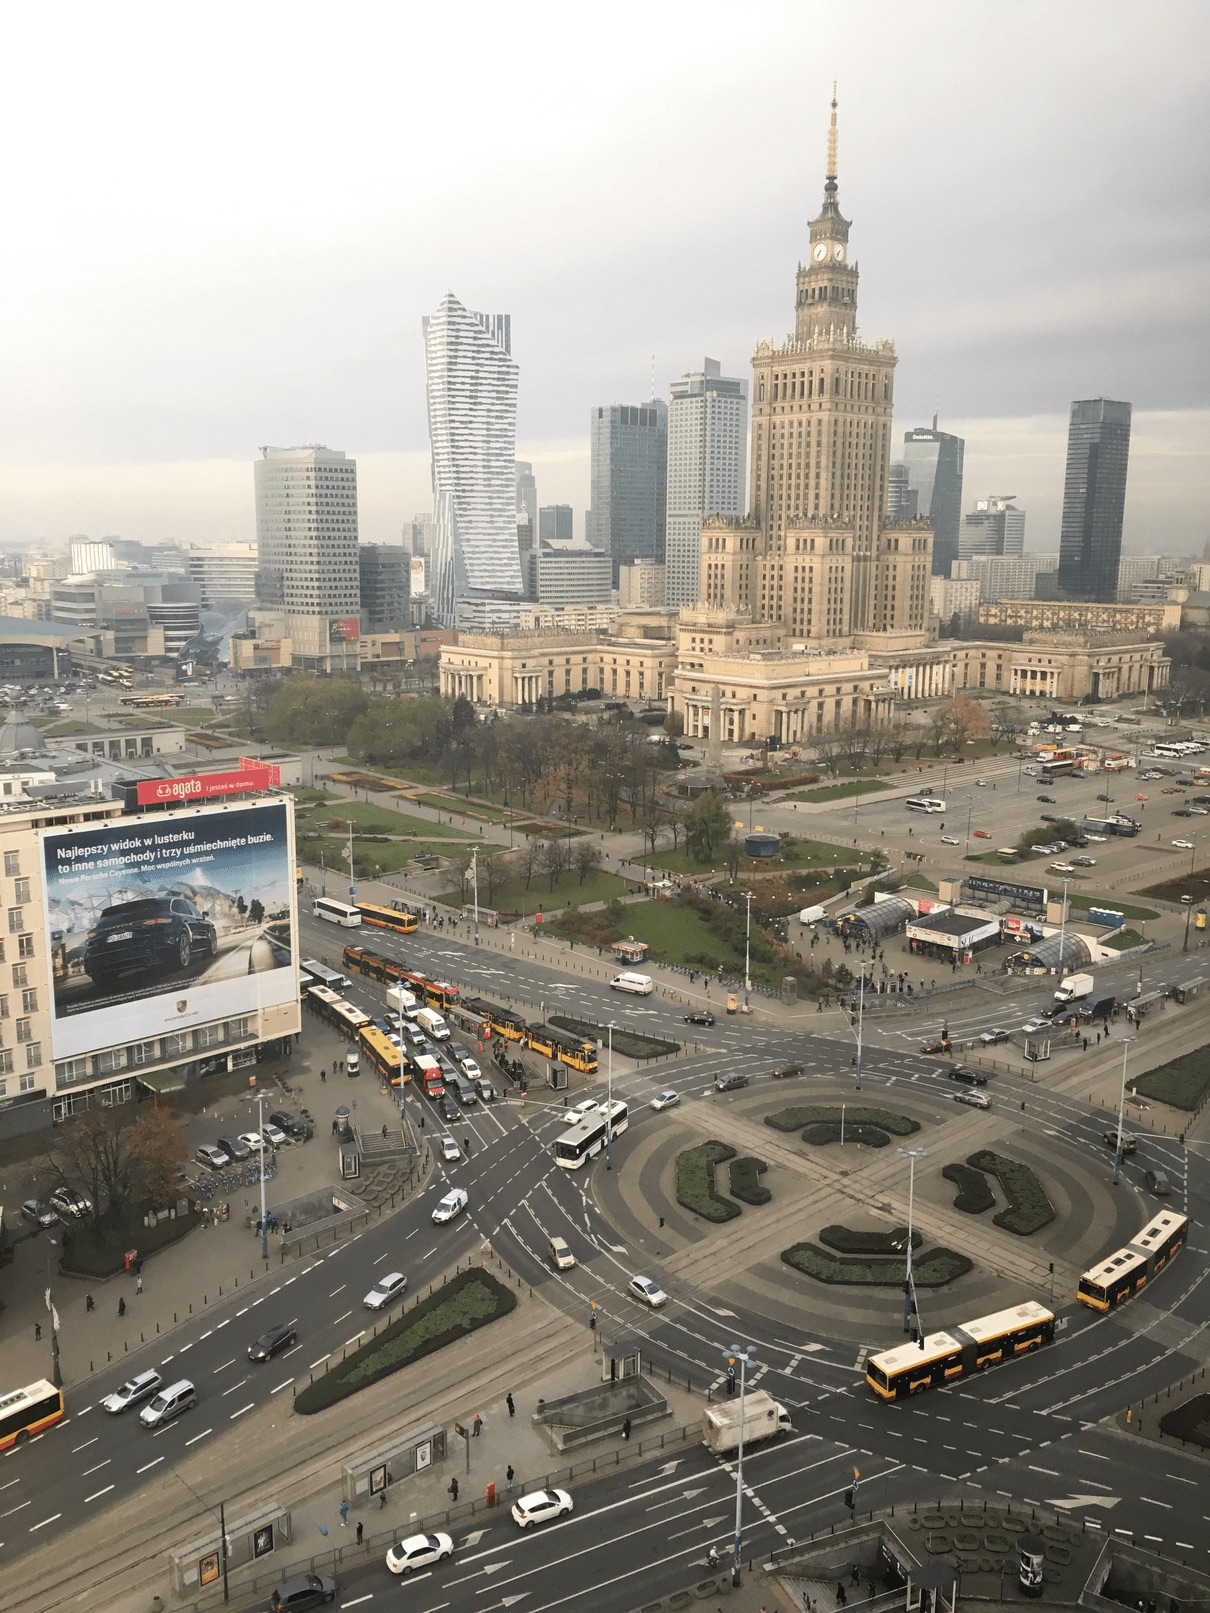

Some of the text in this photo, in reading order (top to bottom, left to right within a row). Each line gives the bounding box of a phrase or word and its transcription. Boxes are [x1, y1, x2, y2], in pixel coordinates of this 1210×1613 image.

[172, 779, 201, 798] agata
[57, 830, 195, 860] Najlepszy widok w lusterku
[58, 864, 70, 874] to
[72, 862, 95, 872] inne
[97, 850, 156, 868] samochody
[162, 847, 182, 858] trzy
[183, 837, 246, 855] uśmiechnięte
[247, 832, 274, 845] buzie.
[59, 876, 79, 885] Nowe
[80, 872, 108, 882] Porsche
[141, 864, 155, 872] Moc
[156, 858, 191, 869] wspólnych
[192, 854, 215, 864] wrażeń.
